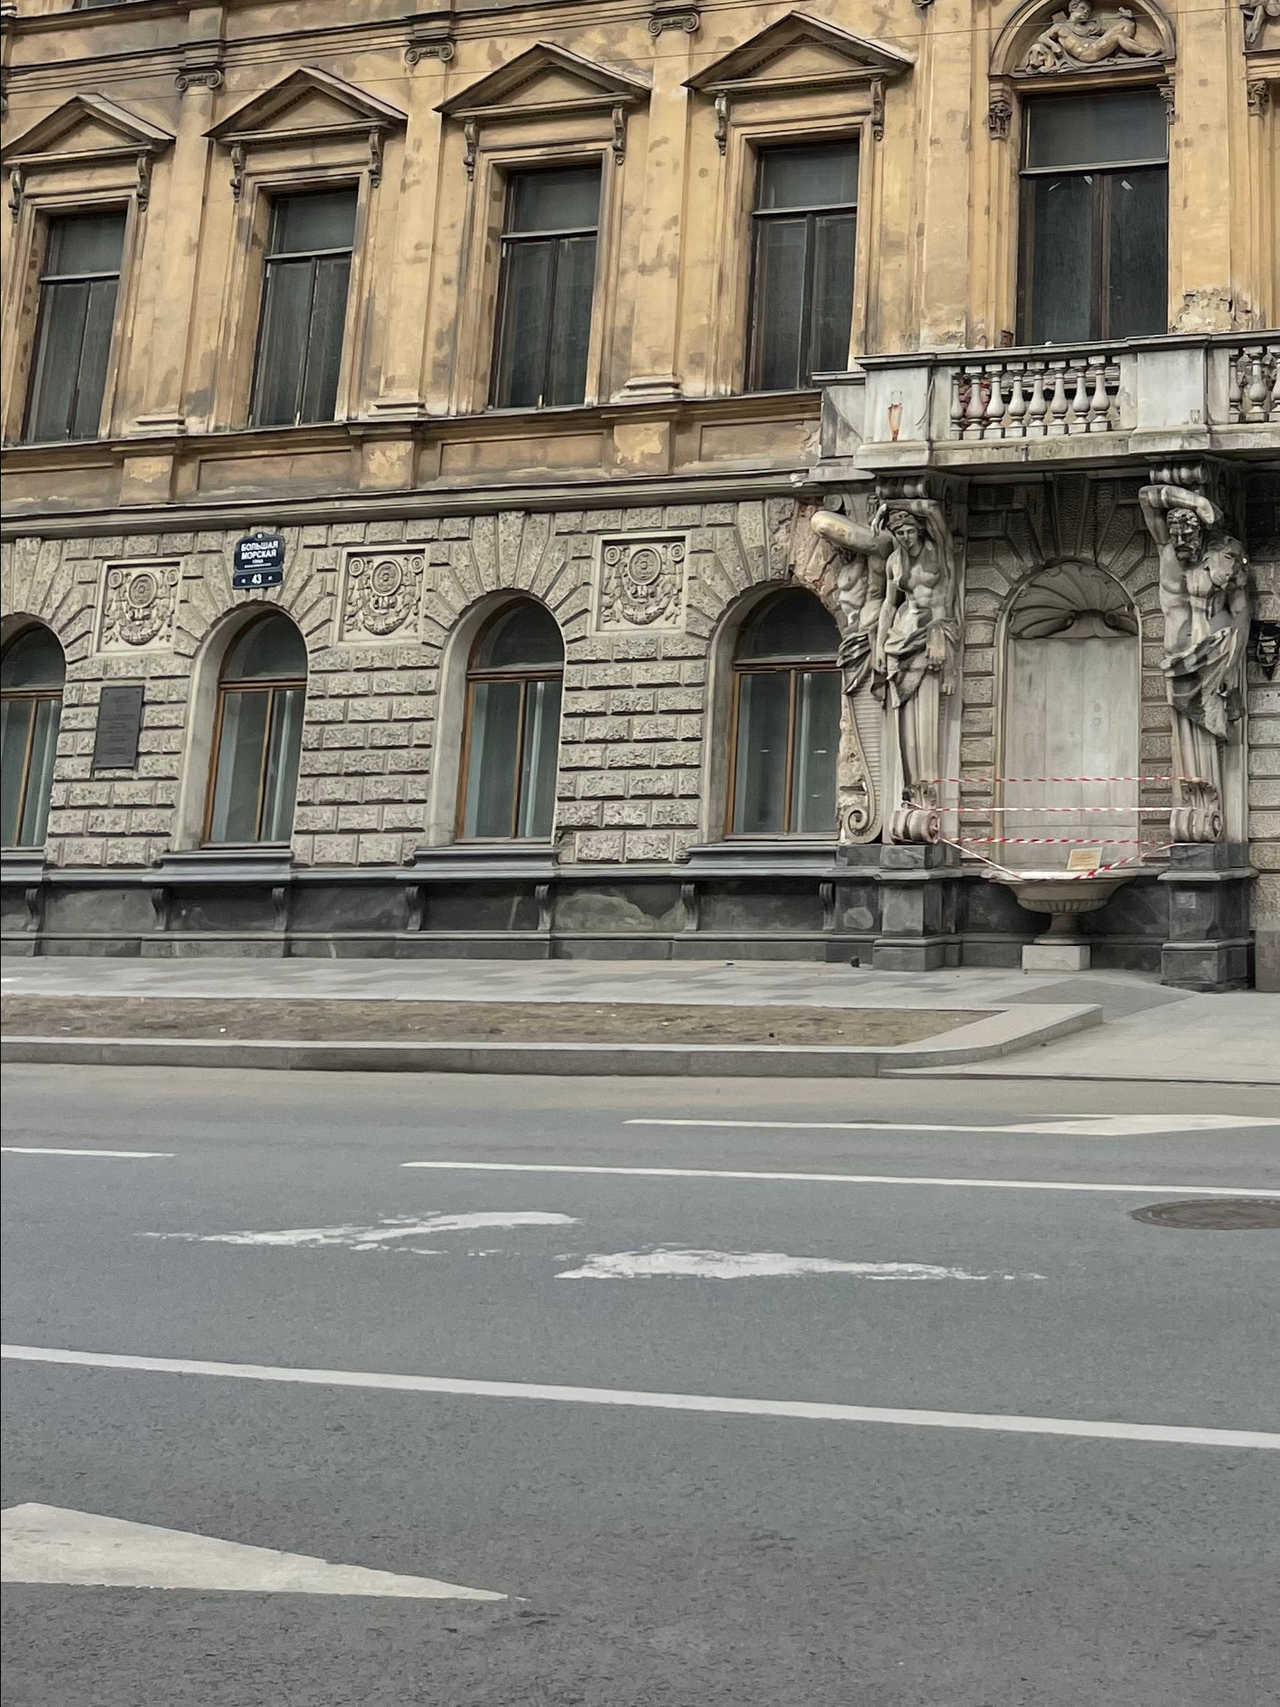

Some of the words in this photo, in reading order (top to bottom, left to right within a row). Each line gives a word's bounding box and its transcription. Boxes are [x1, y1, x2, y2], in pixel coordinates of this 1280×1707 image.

[241, 541, 278, 551] БОЛЬШАЯ
[241, 549, 276, 560] МОРСКАЯ
[251, 573, 262, 584] 43
